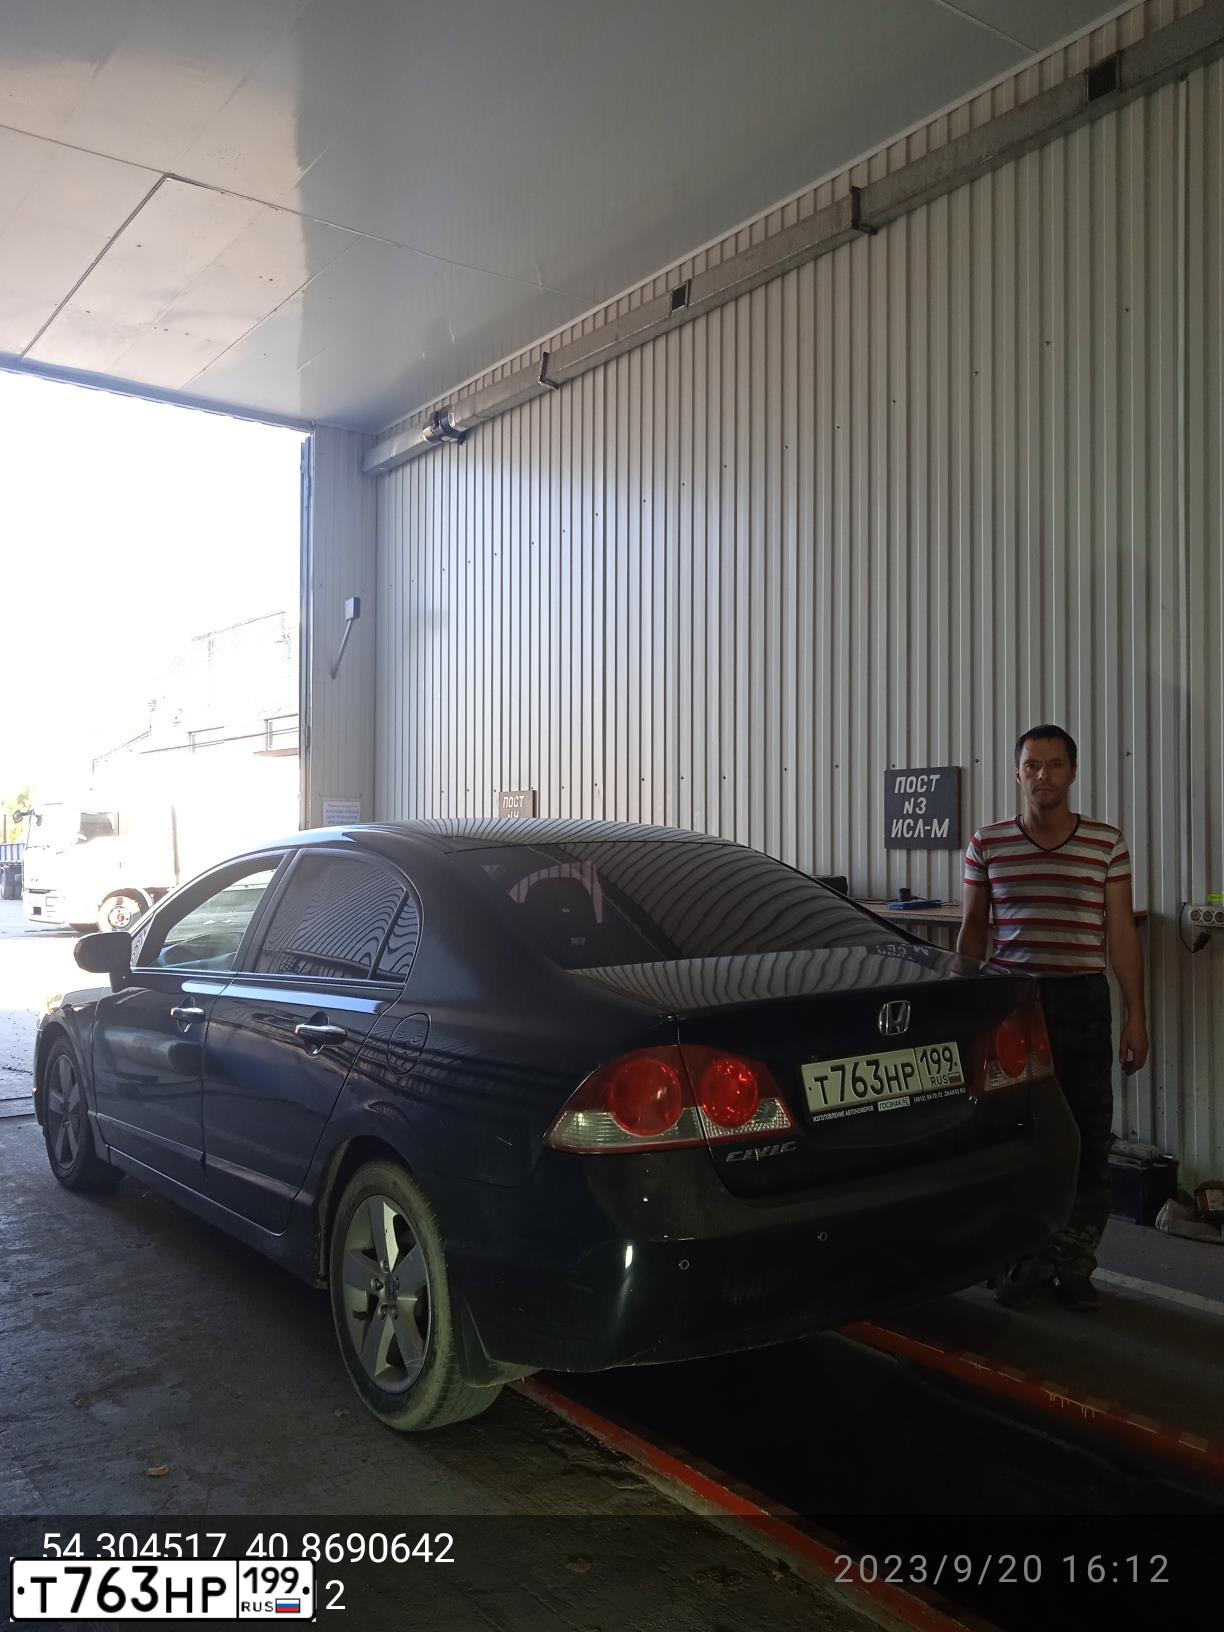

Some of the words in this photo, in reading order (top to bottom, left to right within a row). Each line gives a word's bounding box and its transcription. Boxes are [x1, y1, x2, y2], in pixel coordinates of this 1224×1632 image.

[894, 774, 941, 794] ПОСТ
[502, 795, 525, 809] ПОСТ
[890, 818, 950, 838] ИСЛ-М
[813, 1059, 916, 1105] Т763НР
[919, 1045, 954, 1076] 199
[930, 1075, 949, 1087] RUS
[726, 1141, 797, 1162] CIVIC
